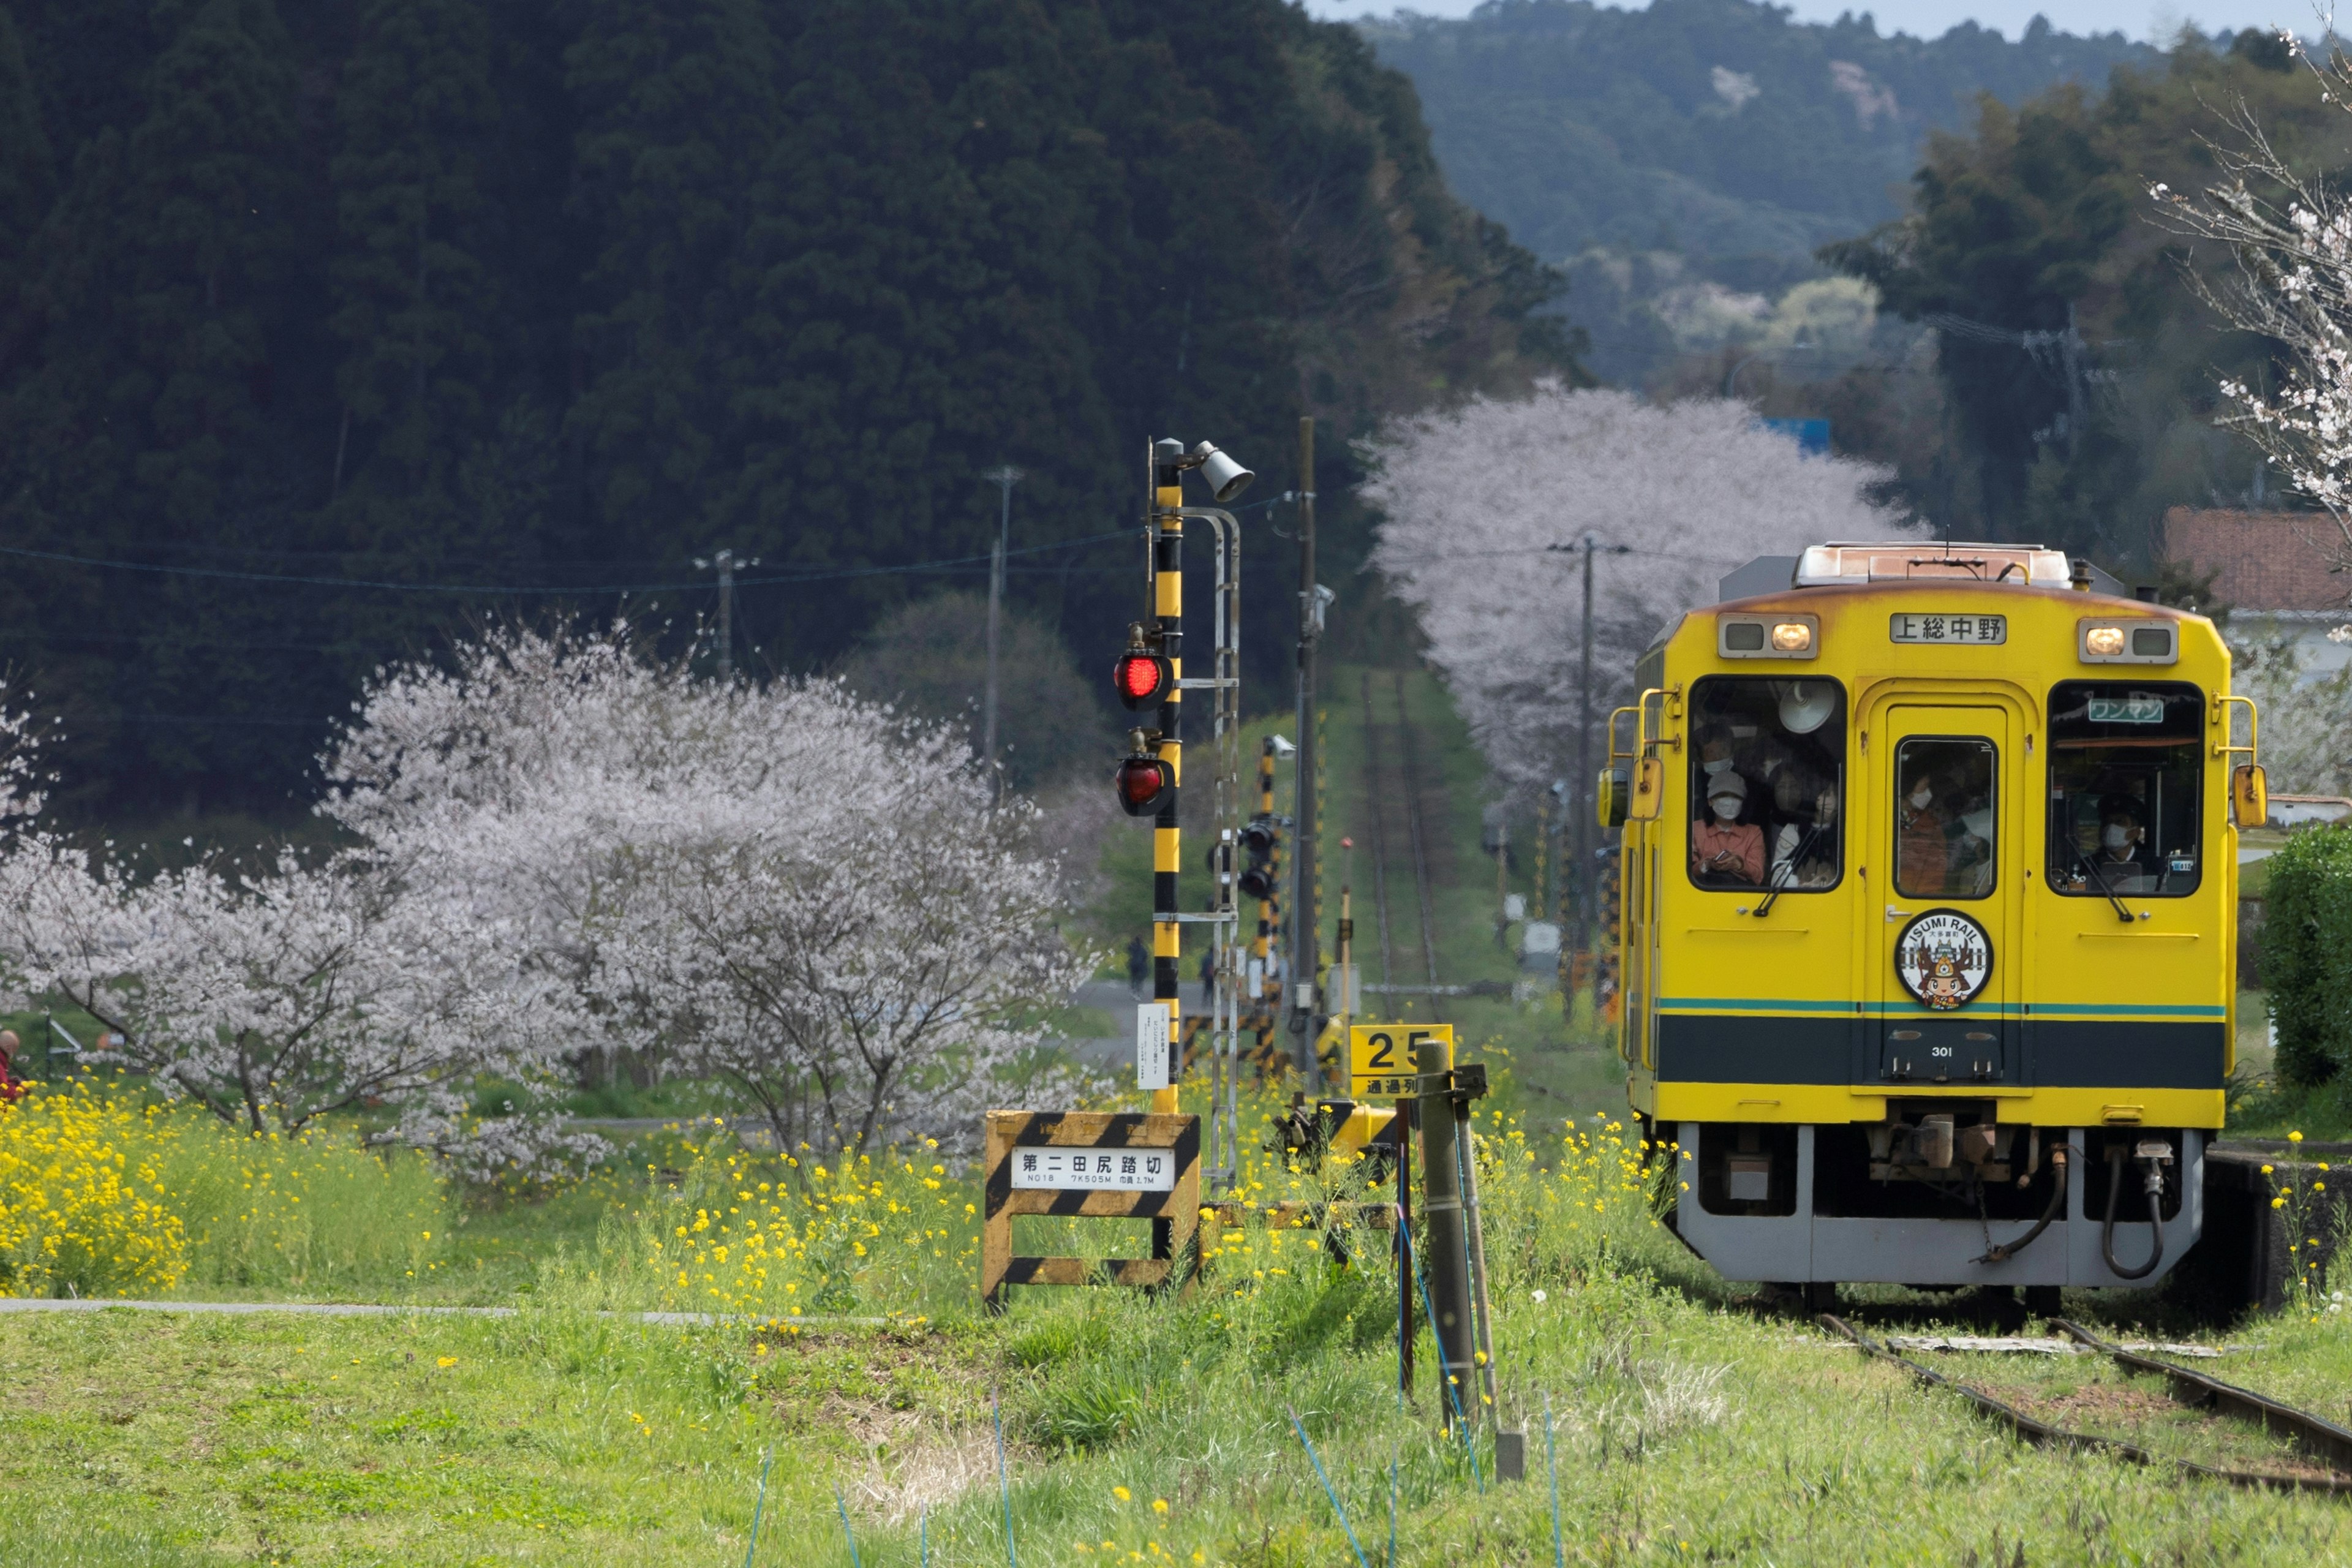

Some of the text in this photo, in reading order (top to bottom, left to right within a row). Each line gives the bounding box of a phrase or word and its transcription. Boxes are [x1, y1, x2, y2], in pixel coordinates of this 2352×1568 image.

[1896, 616, 2000, 641] 上総中野
[2092, 702, 2161, 719] ワンマン
[1909, 918, 1977, 944] ISUMI RAIL
[1368, 1031, 1430, 1068] 25
[1931, 1047, 1952, 1057] 301
[1366, 1079, 1418, 1094] 通過列
[1023, 1153, 1161, 1175] 第二田尻踏切
